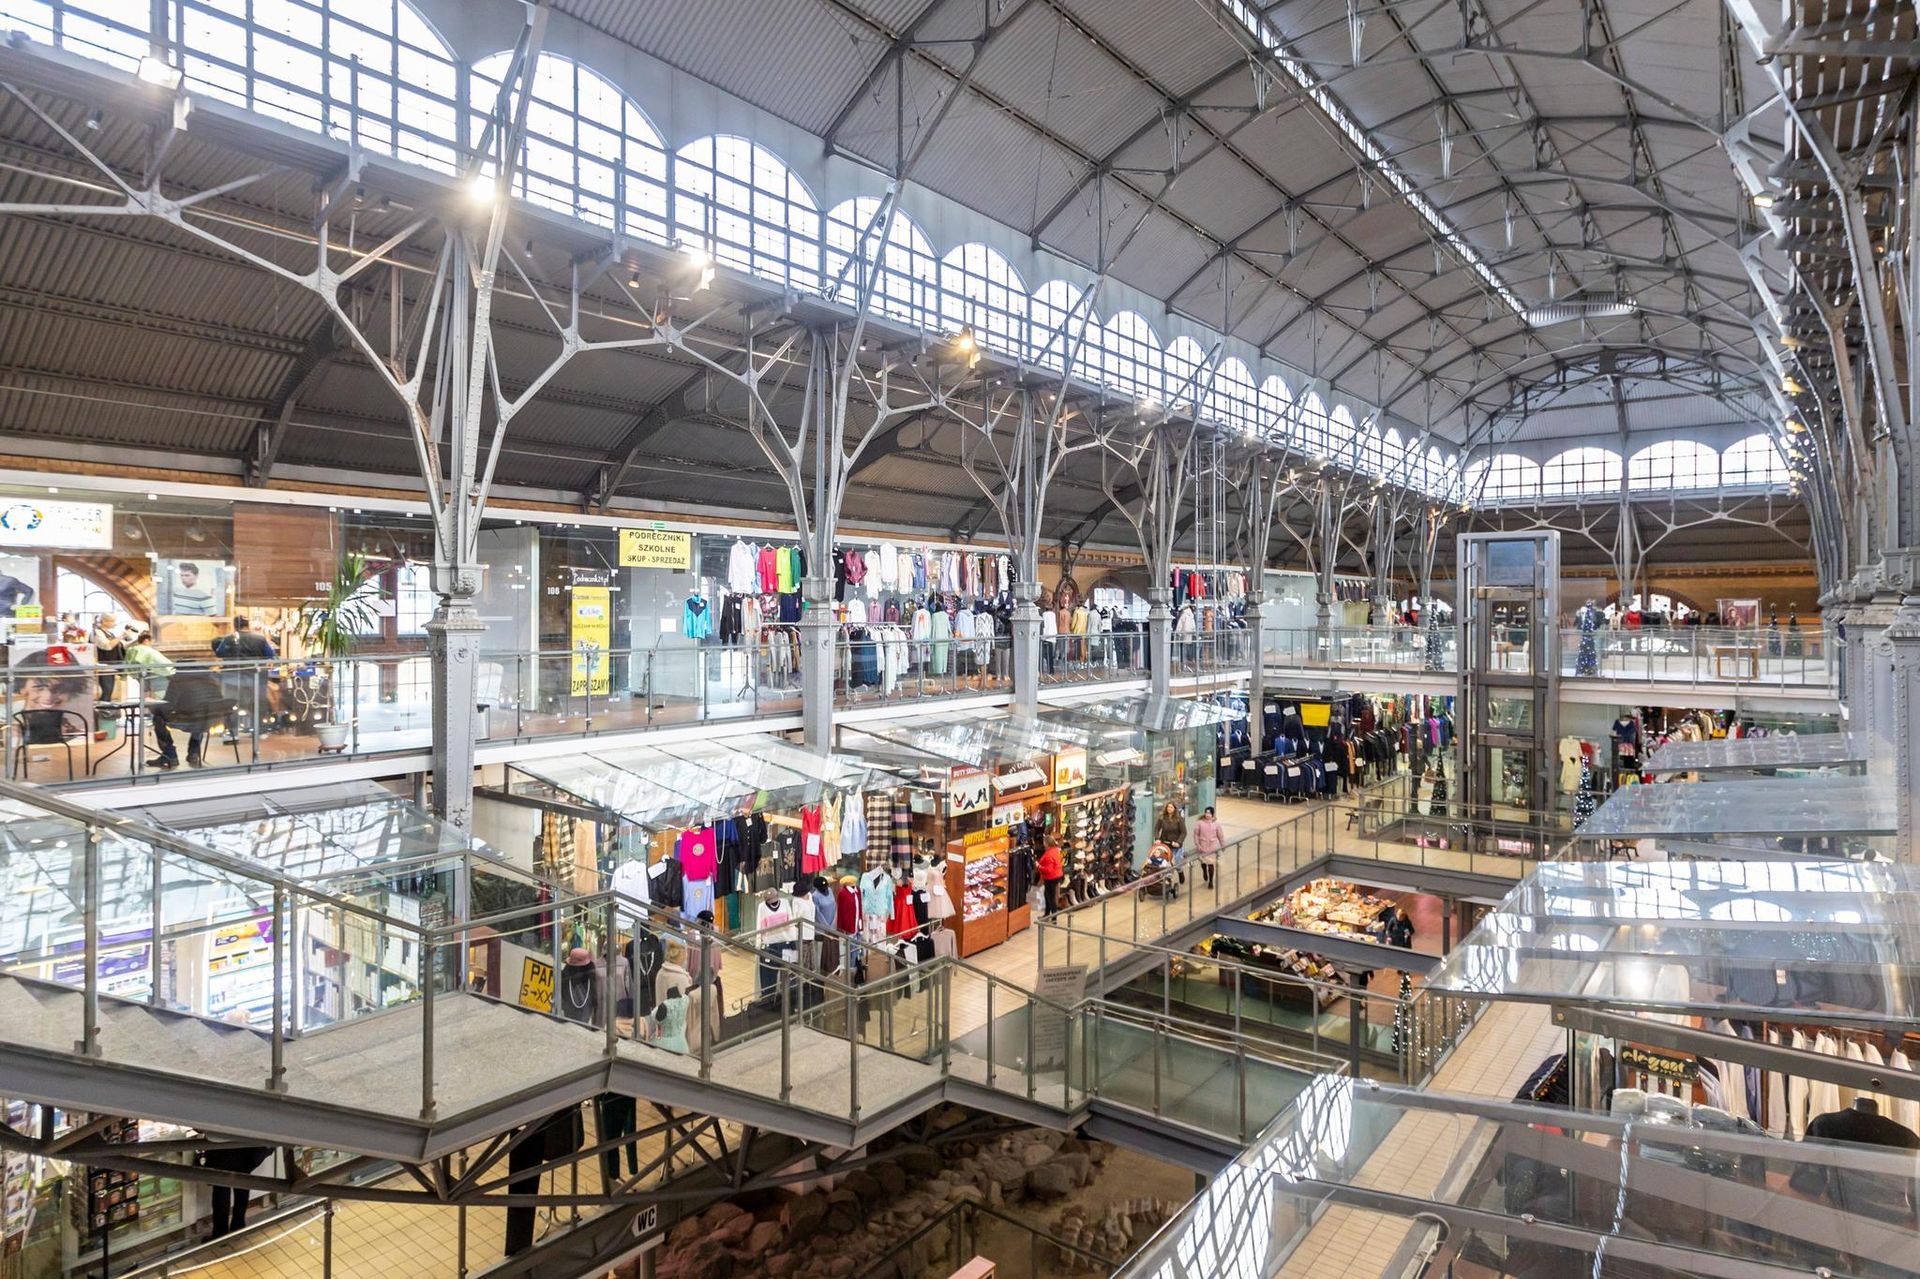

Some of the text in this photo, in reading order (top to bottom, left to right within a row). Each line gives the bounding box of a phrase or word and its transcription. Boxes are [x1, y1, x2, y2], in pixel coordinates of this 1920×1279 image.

[638, 544, 676, 553] SZKOLNE
[627, 554, 646, 562] SKUP
[315, 582, 332, 591] 105
[638, 1208, 655, 1232] WC
